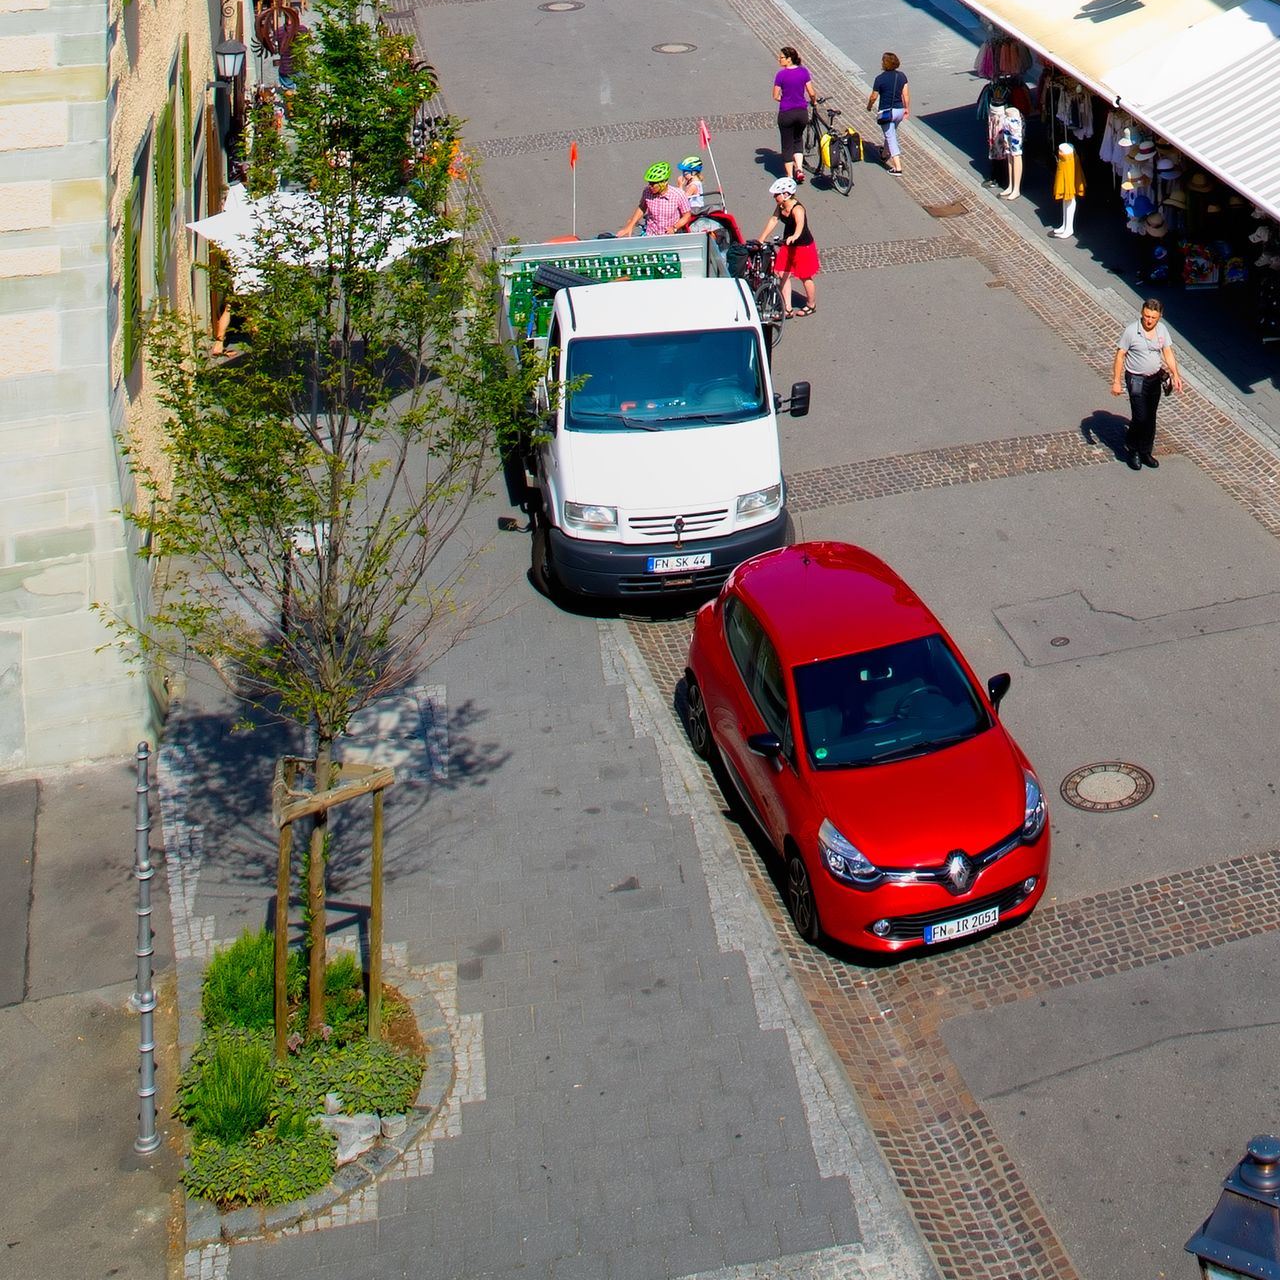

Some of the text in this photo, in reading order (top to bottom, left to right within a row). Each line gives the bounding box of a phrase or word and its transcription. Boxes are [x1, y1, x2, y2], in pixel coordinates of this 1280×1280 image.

[655, 556, 705, 568] FN SK 44
[933, 910, 997, 938] FN IR 2051
